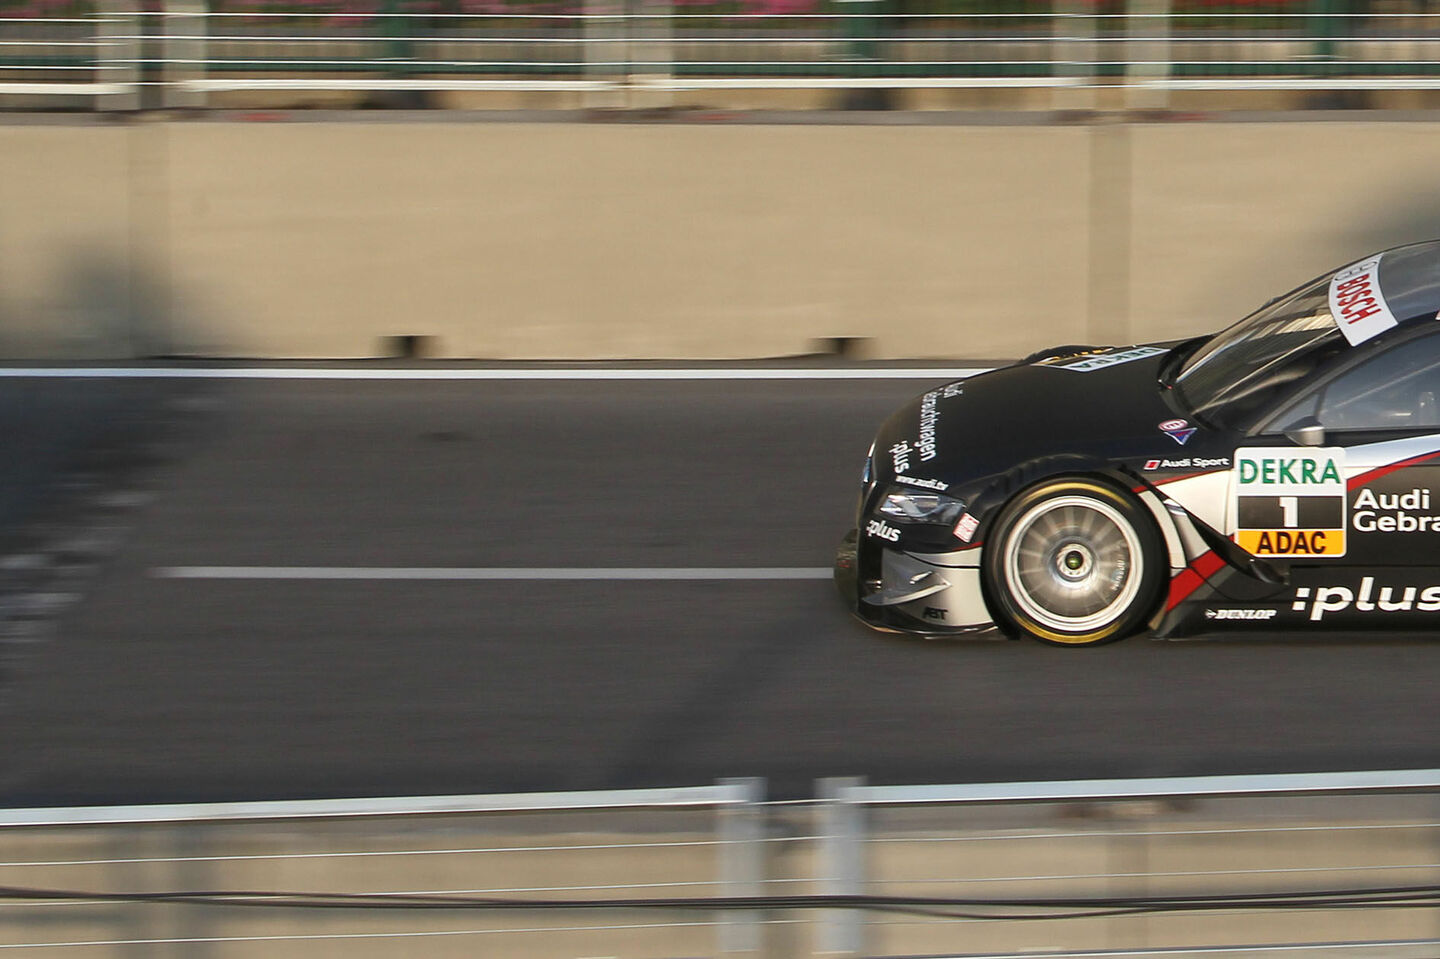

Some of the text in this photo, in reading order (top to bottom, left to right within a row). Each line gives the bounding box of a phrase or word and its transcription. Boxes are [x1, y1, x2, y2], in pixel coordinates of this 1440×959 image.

[1336, 273, 1382, 325] BOSCH
[1161, 457, 1230, 469] Audi Sport
[1238, 458, 1342, 485] DEKRA
[1352, 488, 1431, 510] Audi
[1278, 496, 1299, 528] 1
[1254, 530, 1327, 556] ADAC
[922, 606, 949, 620] ABT
[1214, 609, 1278, 620] DUNLOP
